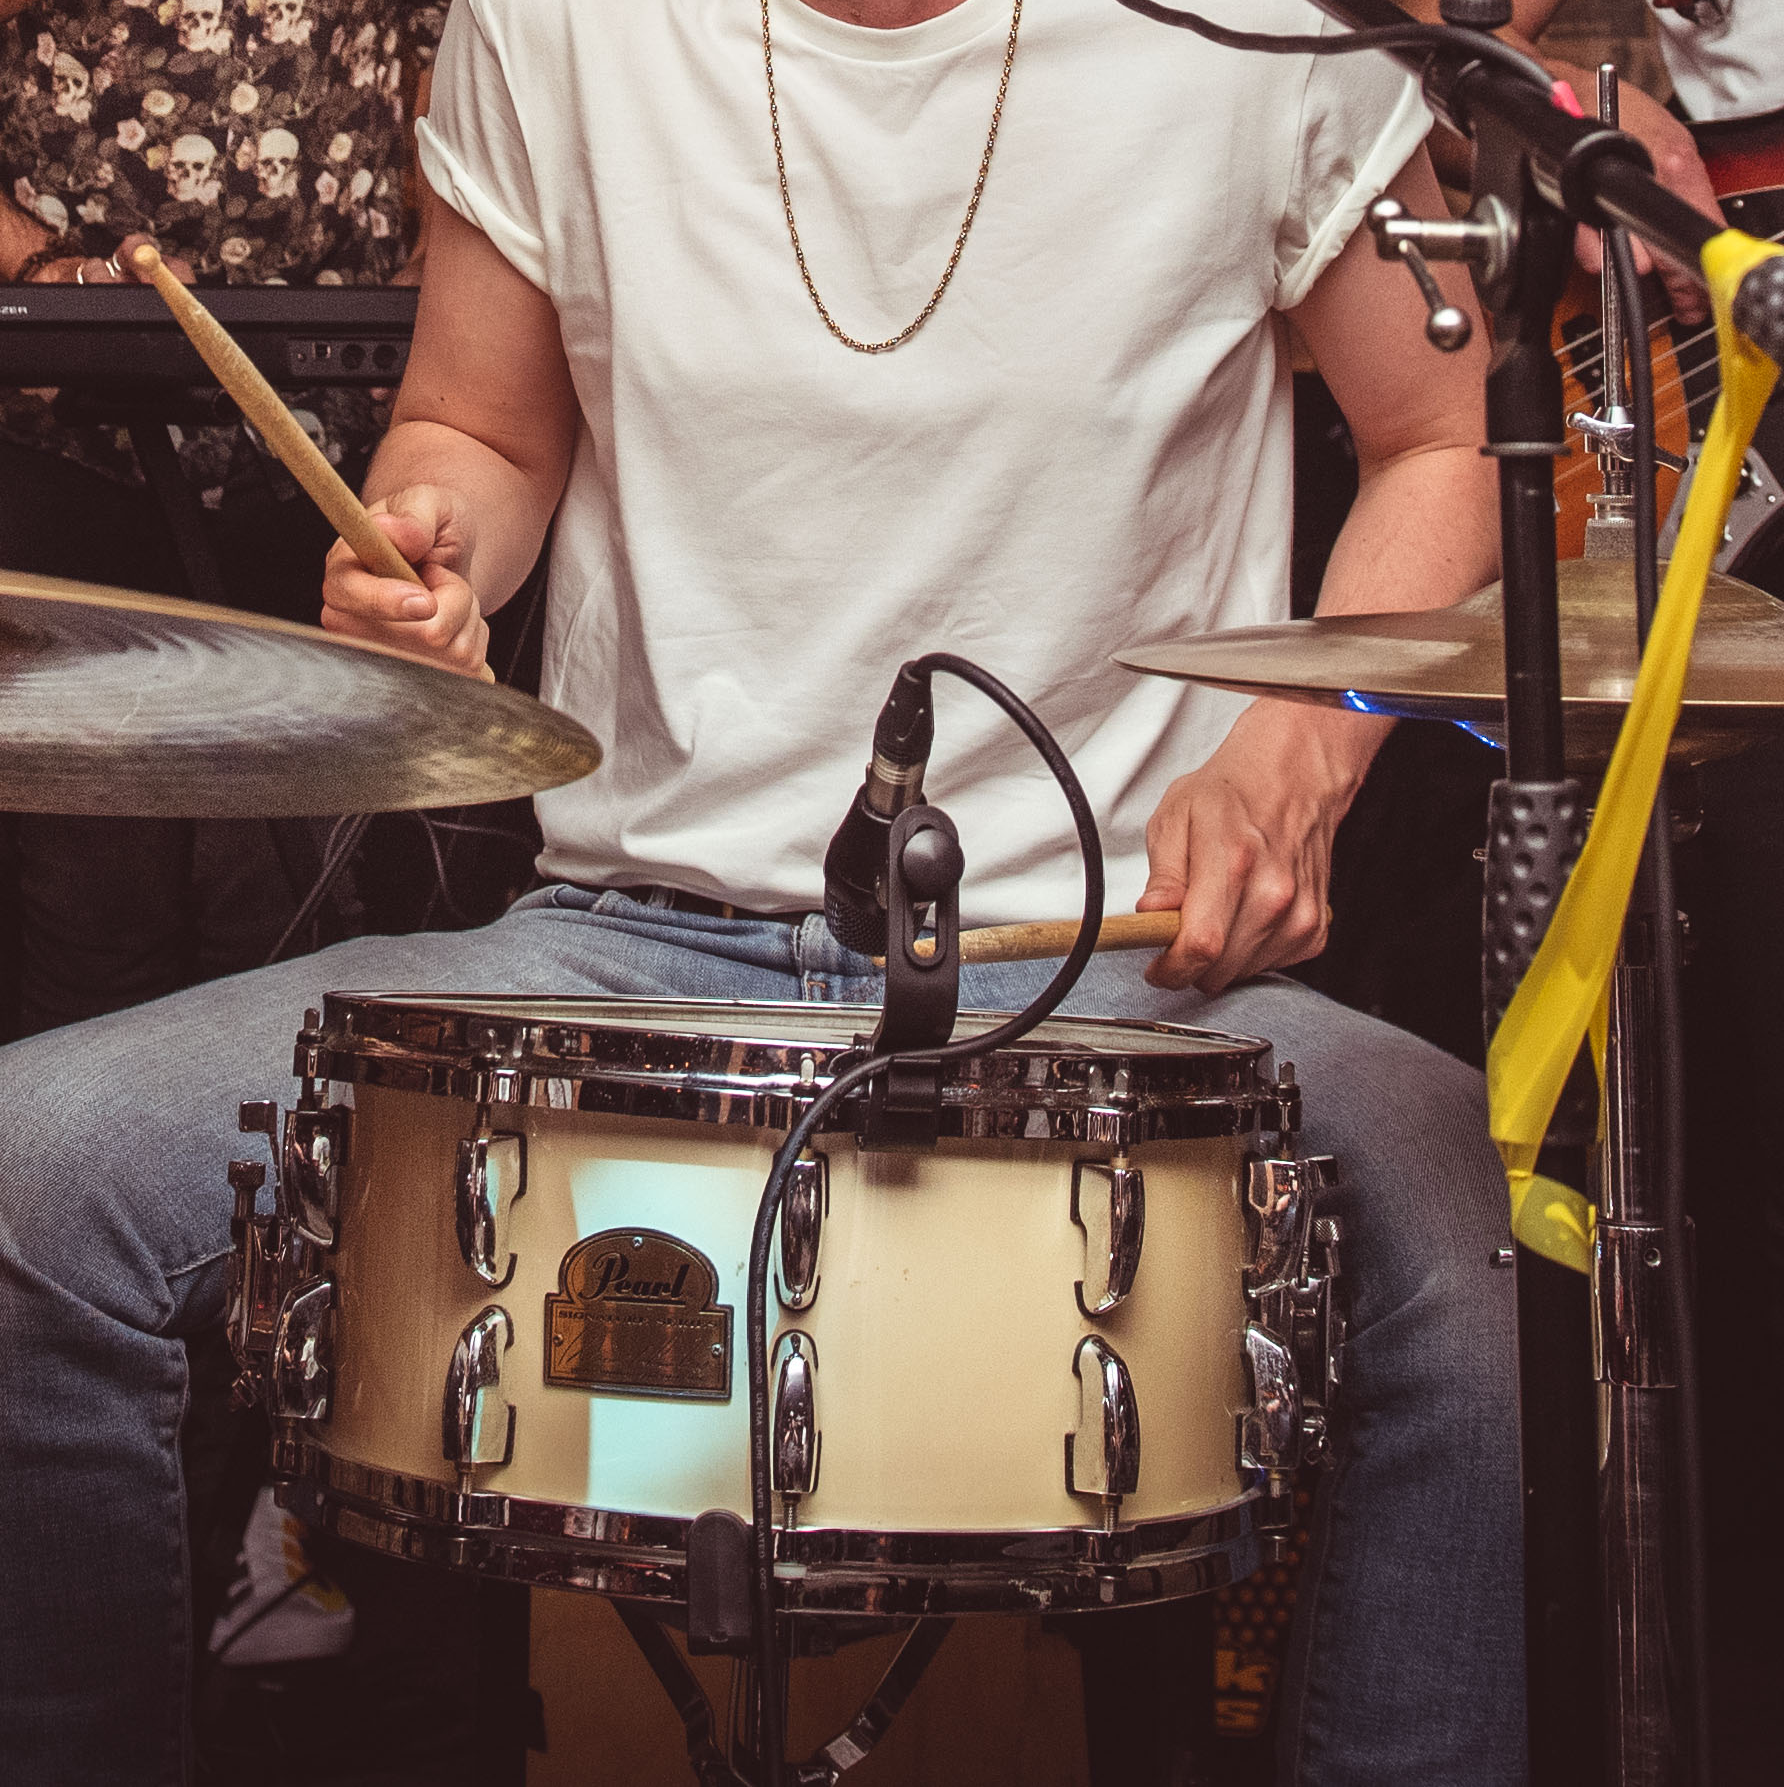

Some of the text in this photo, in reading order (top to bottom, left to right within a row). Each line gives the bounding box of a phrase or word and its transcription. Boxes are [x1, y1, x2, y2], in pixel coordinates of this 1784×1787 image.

[578, 1251, 691, 1300] Pearl
[557, 1309, 718, 1331] SIGNATURE SERIES
[755, 1392, 764, 1426] ULTRA
[756, 1434, 764, 1462] PURE
[756, 1473, 765, 1510] SILVER
[756, 1517, 767, 1559] PLATED
[759, 1567, 767, 1591] OFC
